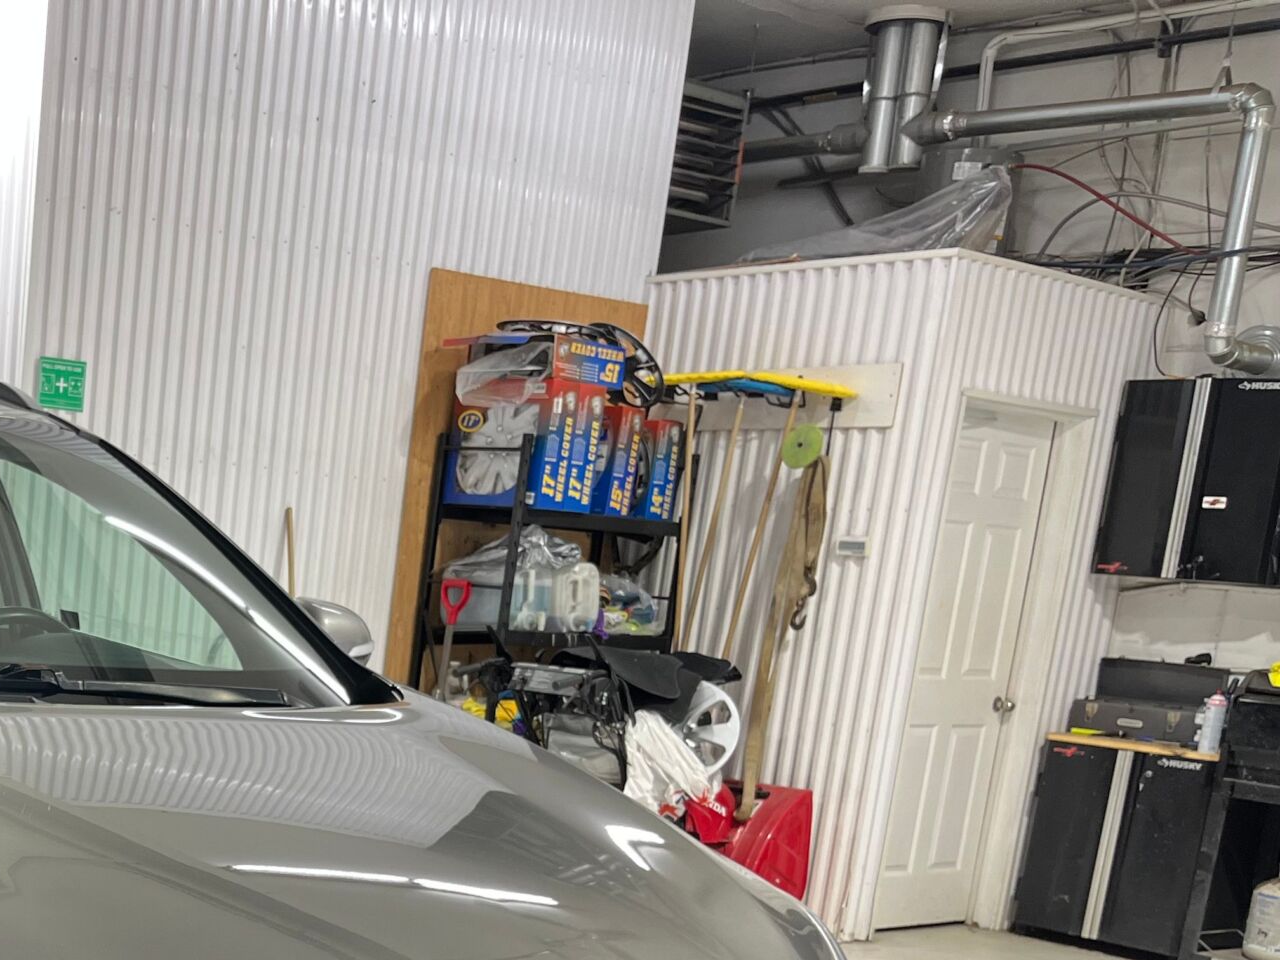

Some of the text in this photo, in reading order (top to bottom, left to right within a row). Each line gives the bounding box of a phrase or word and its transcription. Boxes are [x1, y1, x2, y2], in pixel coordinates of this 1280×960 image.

[555, 416, 573, 502] WHEEL COVER
[581, 421, 600, 505] WHEEL COVER
[621, 432, 640, 516] WHEEL COVER
[662, 483, 673, 519] WHEEL
